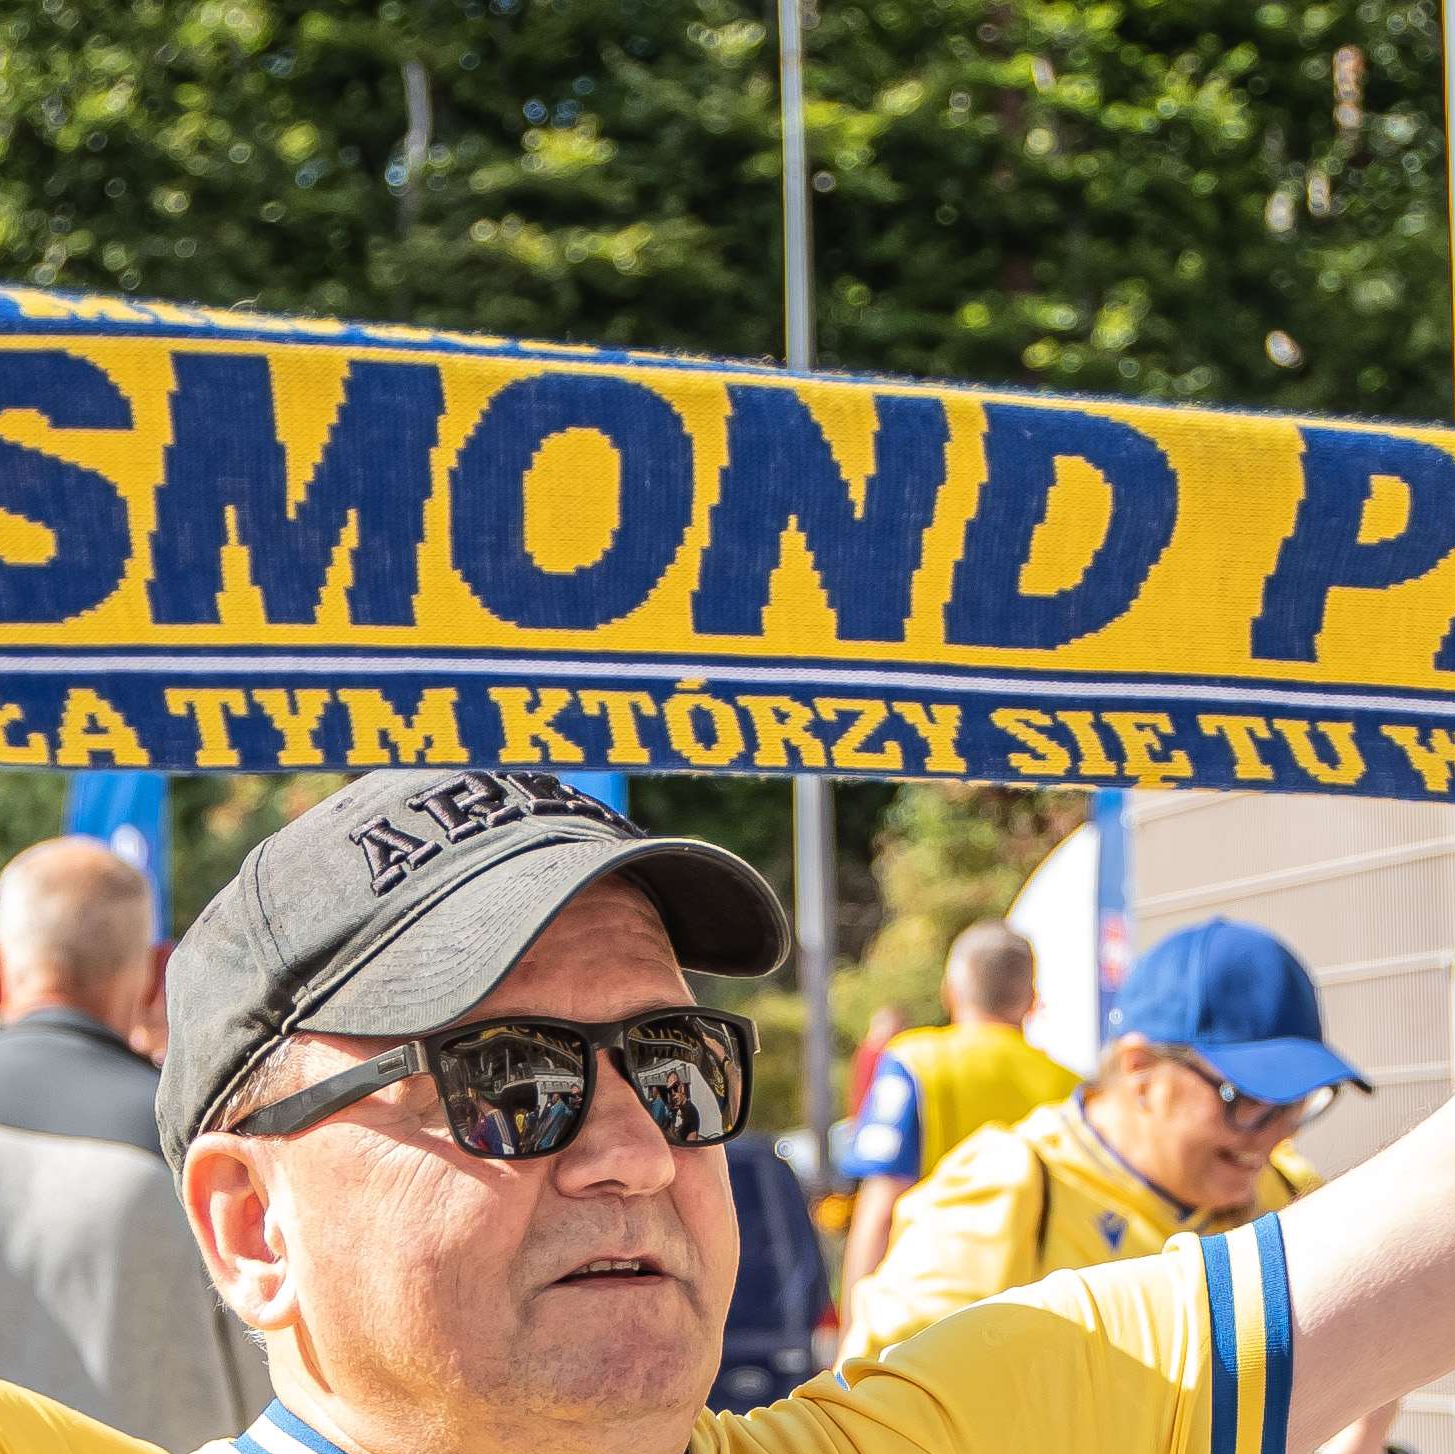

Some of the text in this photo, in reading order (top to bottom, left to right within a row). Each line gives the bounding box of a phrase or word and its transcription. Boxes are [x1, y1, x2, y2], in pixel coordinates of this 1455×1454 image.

[165, 686, 470, 768] TYM
[488, 677, 968, 774] KTÓRZY
[989, 708, 1194, 789] SIĘ
[1198, 714, 1367, 786] TU
